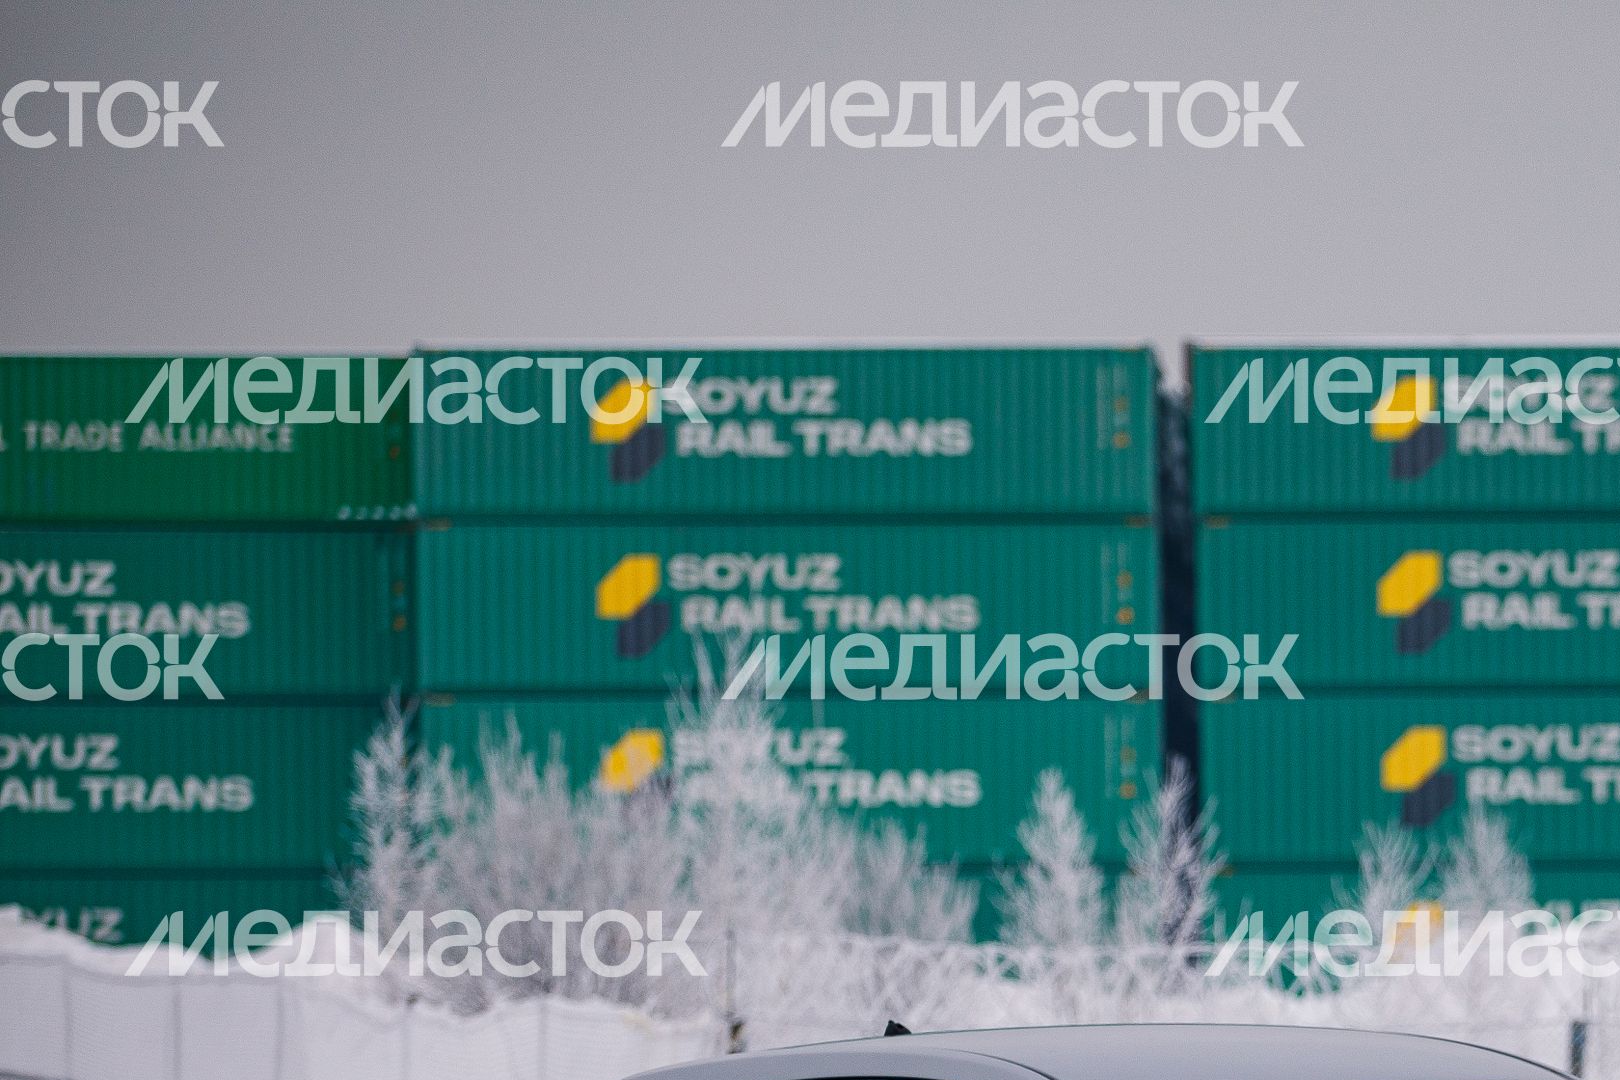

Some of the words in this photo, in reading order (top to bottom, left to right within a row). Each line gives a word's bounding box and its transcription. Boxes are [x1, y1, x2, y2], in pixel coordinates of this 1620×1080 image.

[661, 375, 839, 415] SOYUZ
[22, 420, 124, 453] TRADE
[138, 420, 295, 453] ALLIANCE
[675, 419, 792, 458] RAIL
[792, 418, 973, 458] TRANS
[1455, 416, 1572, 455] RAIL
[668, 552, 842, 592] SOYUZ
[73, 602, 250, 638] TRANS
[680, 596, 800, 634] RAIL
[802, 594, 981, 634] TRANS
[1461, 591, 1577, 631] RAIL
[81, 776, 254, 811] TRANS
[807, 769, 982, 807] TRANS
[1466, 766, 1581, 804] RAIL
